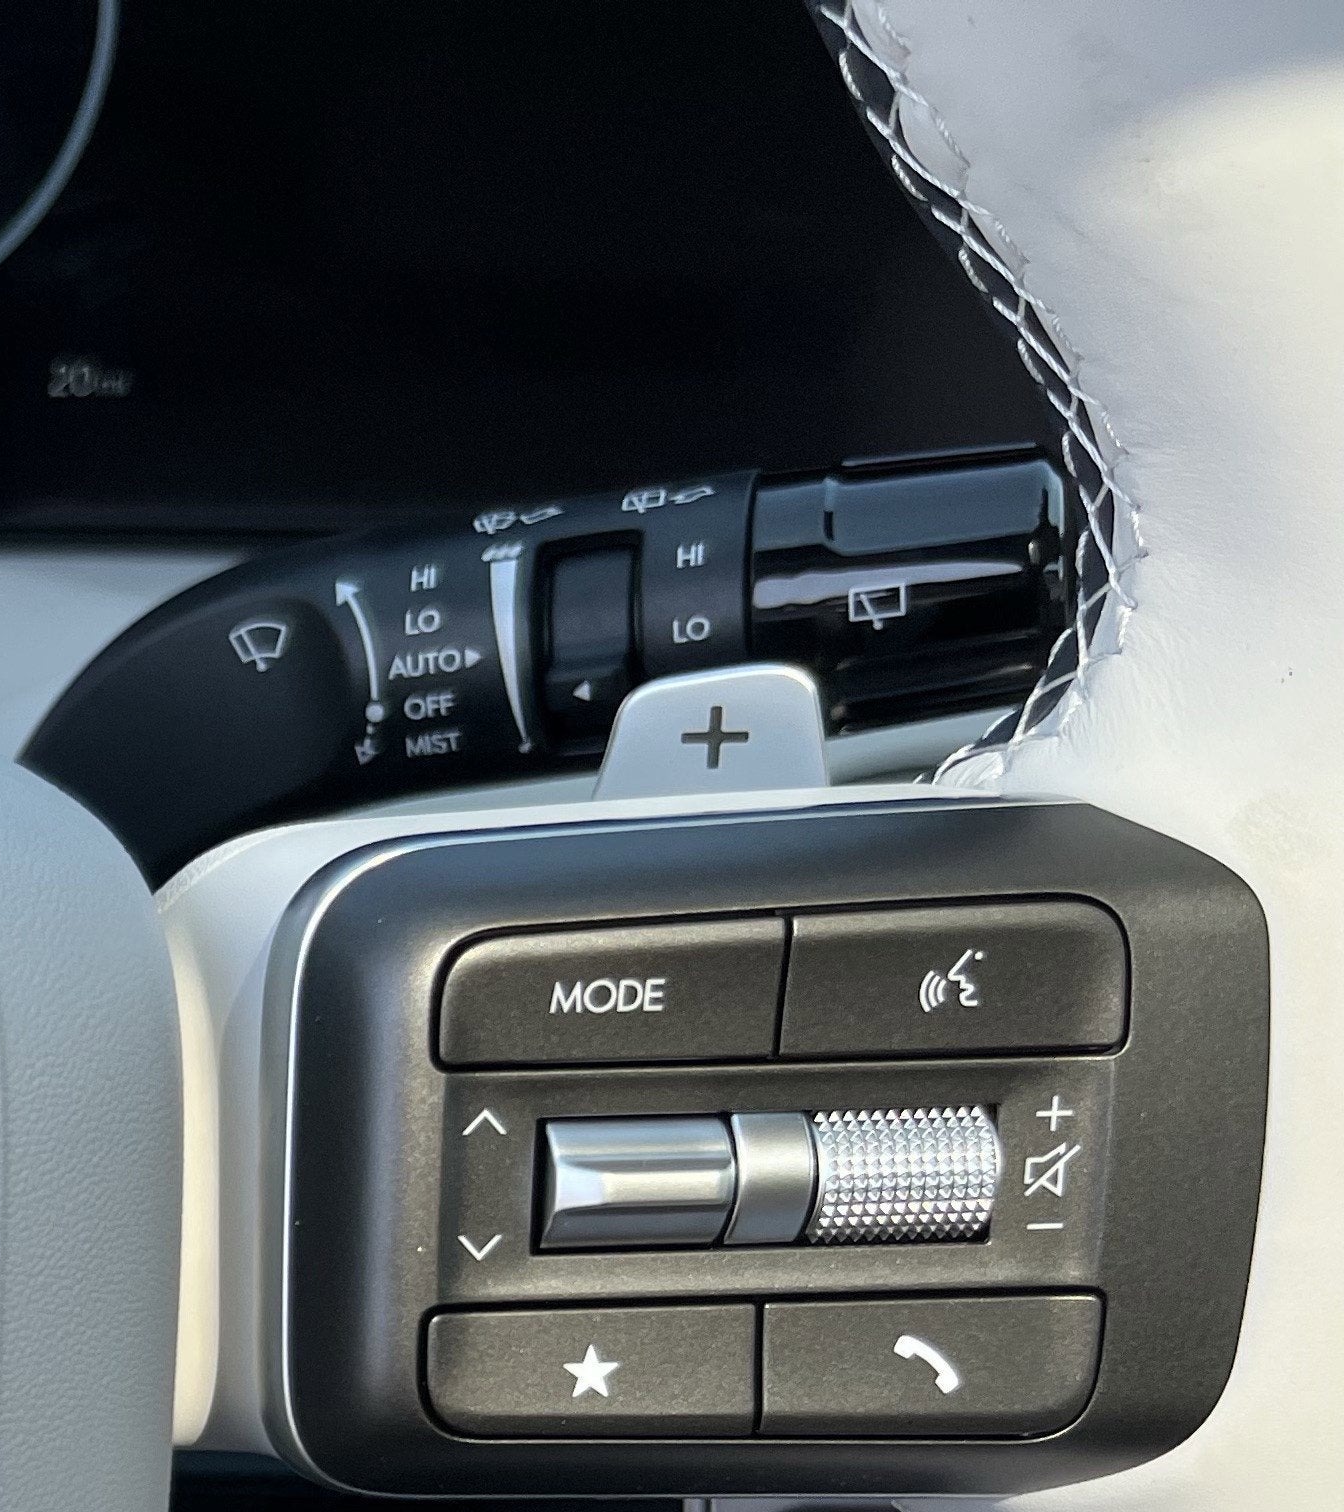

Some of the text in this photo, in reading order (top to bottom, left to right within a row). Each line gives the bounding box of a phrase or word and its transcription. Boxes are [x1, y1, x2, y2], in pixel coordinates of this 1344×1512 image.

[676, 541, 707, 570] HI
[410, 564, 438, 592] HI
[405, 607, 442, 636] LO
[672, 615, 712, 645] LO
[388, 646, 462, 680] AUTO
[403, 691, 456, 720] OFF
[405, 730, 462, 758] MIST
[548, 977, 667, 1015] MODE
